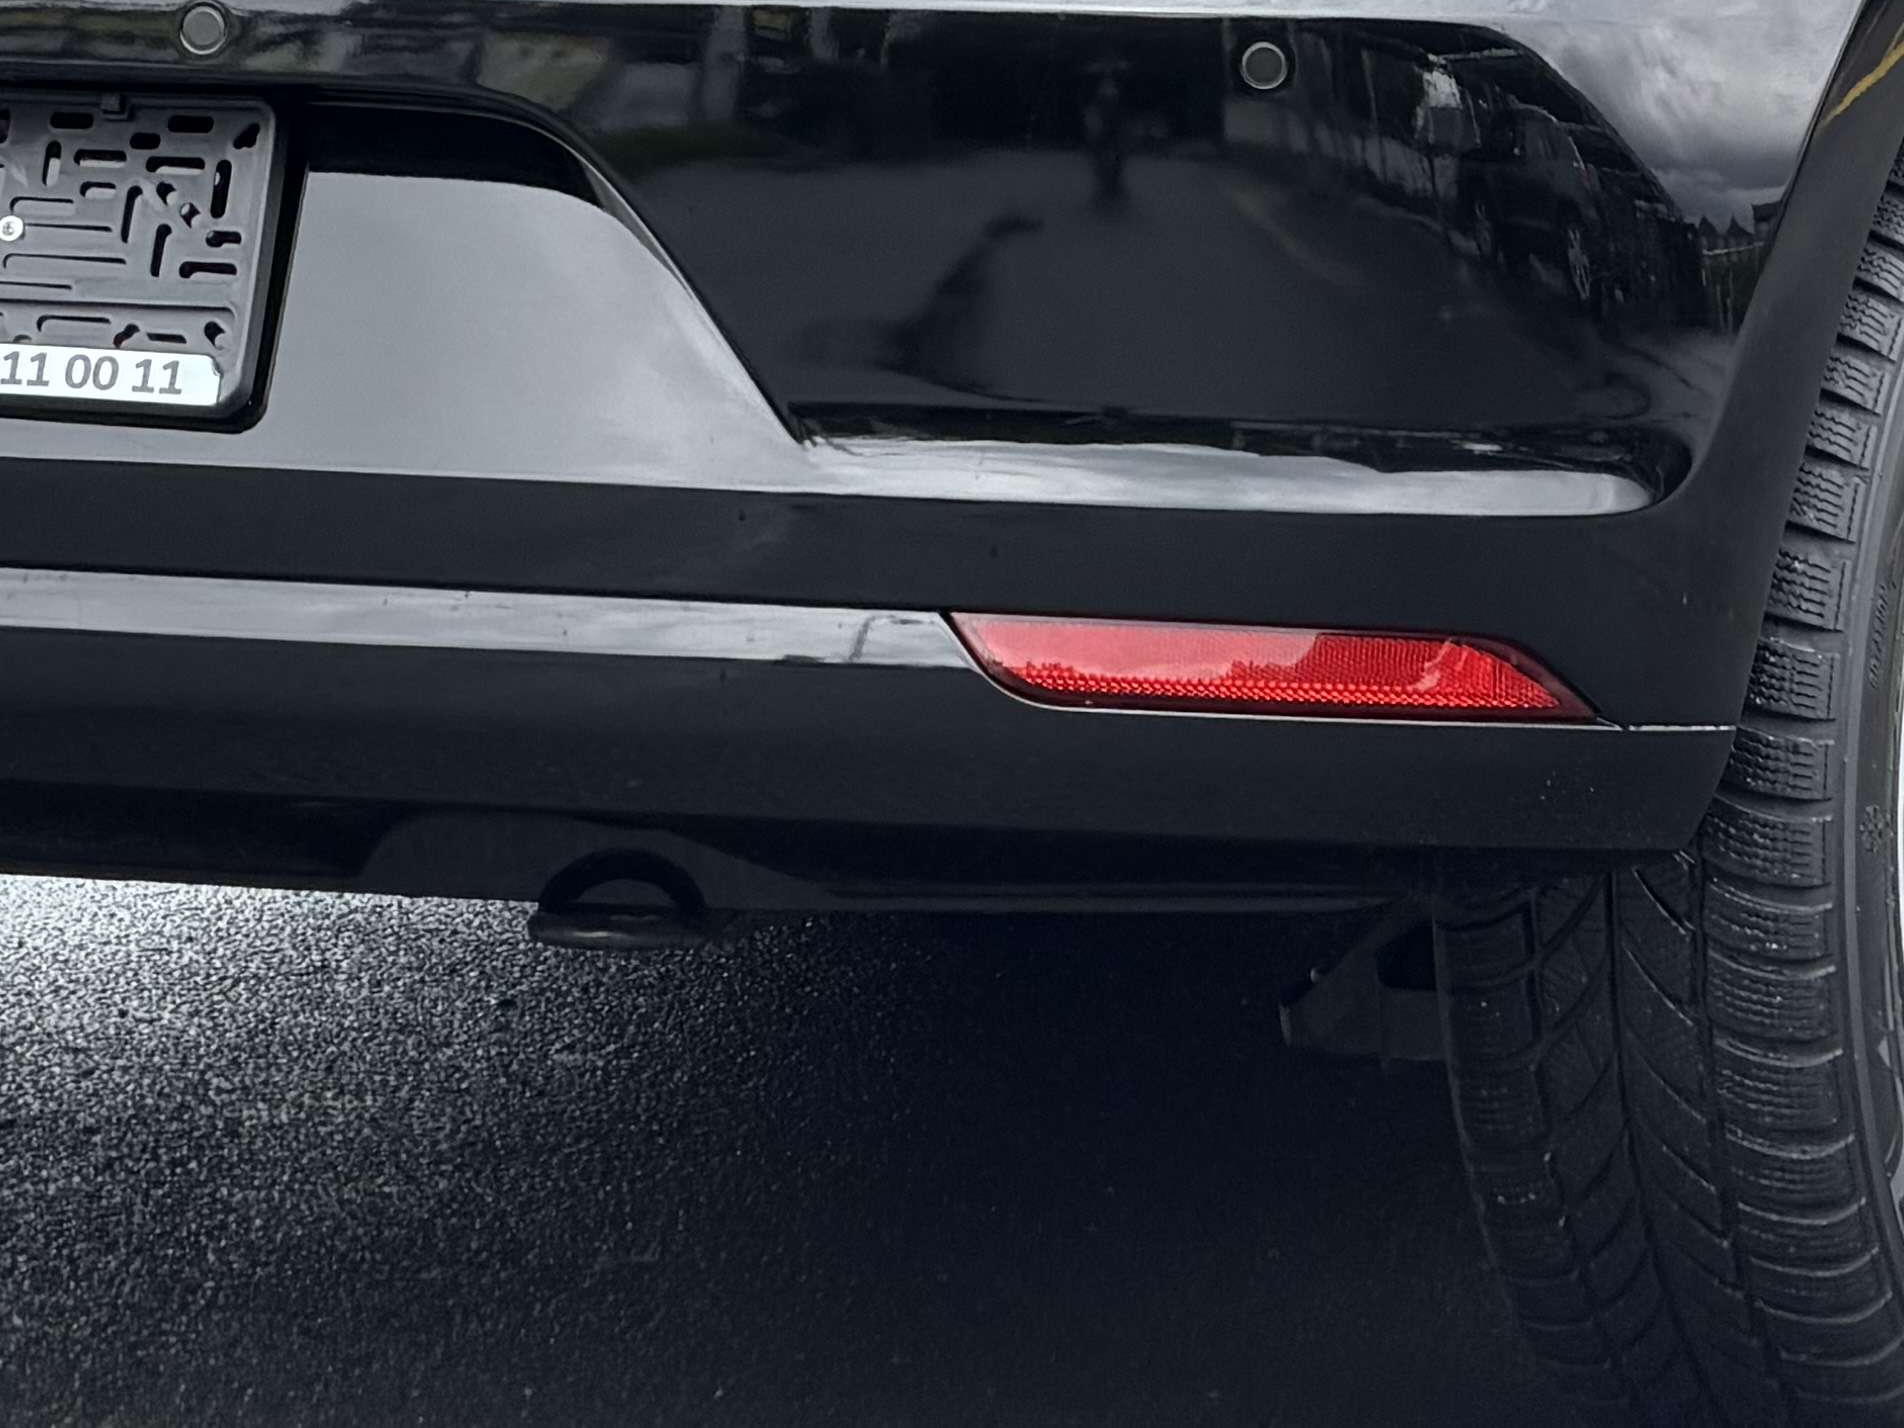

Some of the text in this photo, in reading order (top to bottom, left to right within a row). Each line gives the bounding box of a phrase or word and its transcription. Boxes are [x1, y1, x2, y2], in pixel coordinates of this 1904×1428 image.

[0, 352, 50, 387] 11
[64, 354, 120, 391] 00
[130, 358, 182, 395] 11
